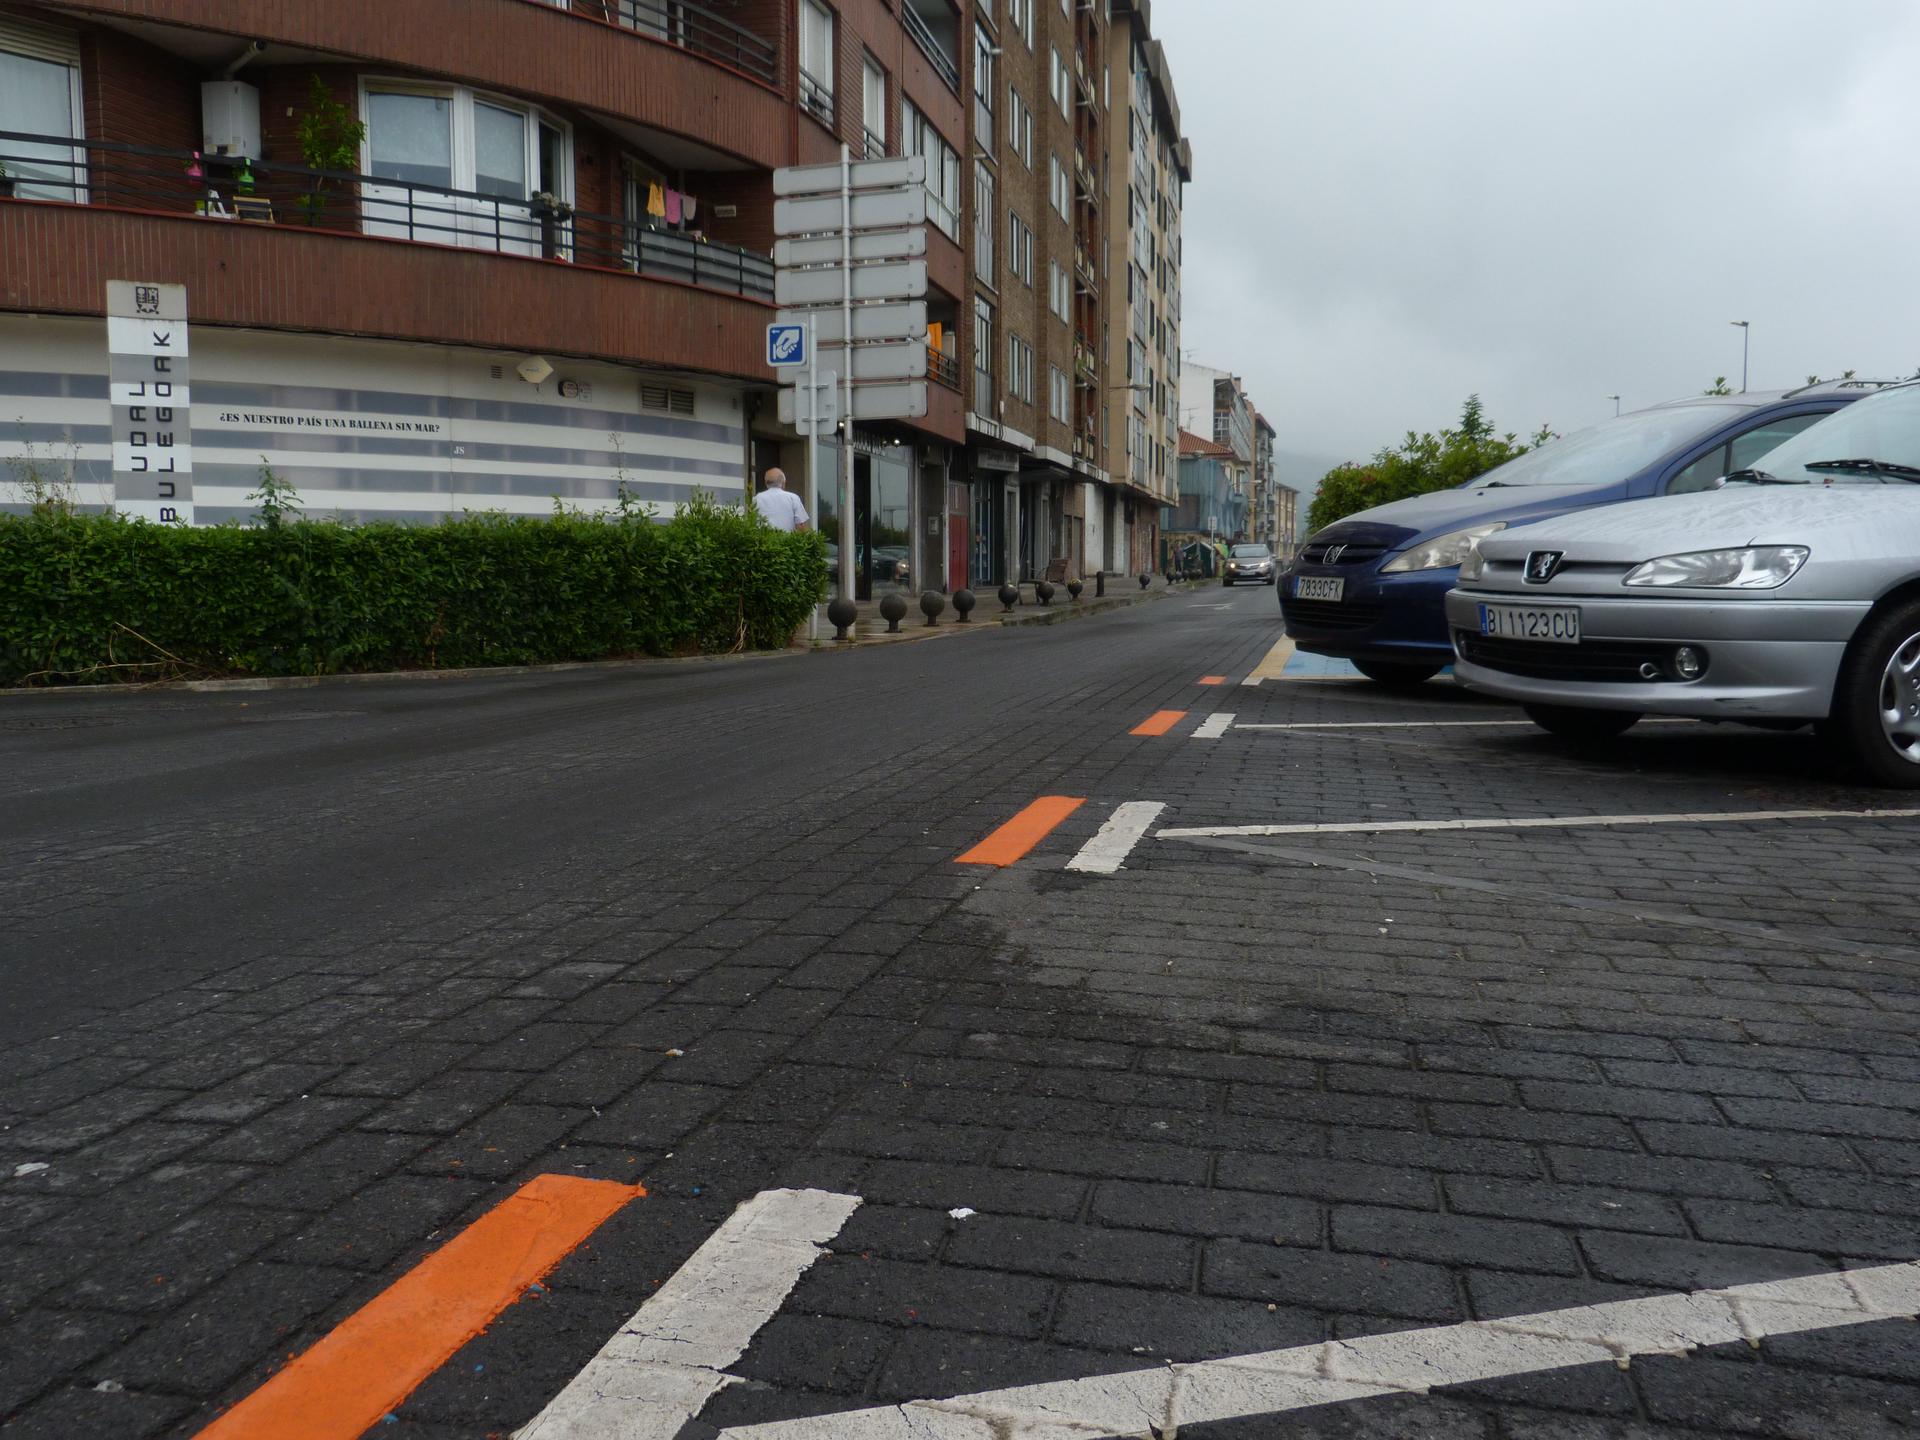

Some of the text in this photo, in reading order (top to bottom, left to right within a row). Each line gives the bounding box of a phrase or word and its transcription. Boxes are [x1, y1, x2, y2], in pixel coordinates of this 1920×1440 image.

[129, 381, 148, 472] UDAL
[153, 331, 177, 523] BULEGOAK
[220, 412, 440, 433] ¿ES NUESTRO PAÍS UNA BALLENA SIN MAR?
[1300, 578, 1341, 598] 7833CFK
